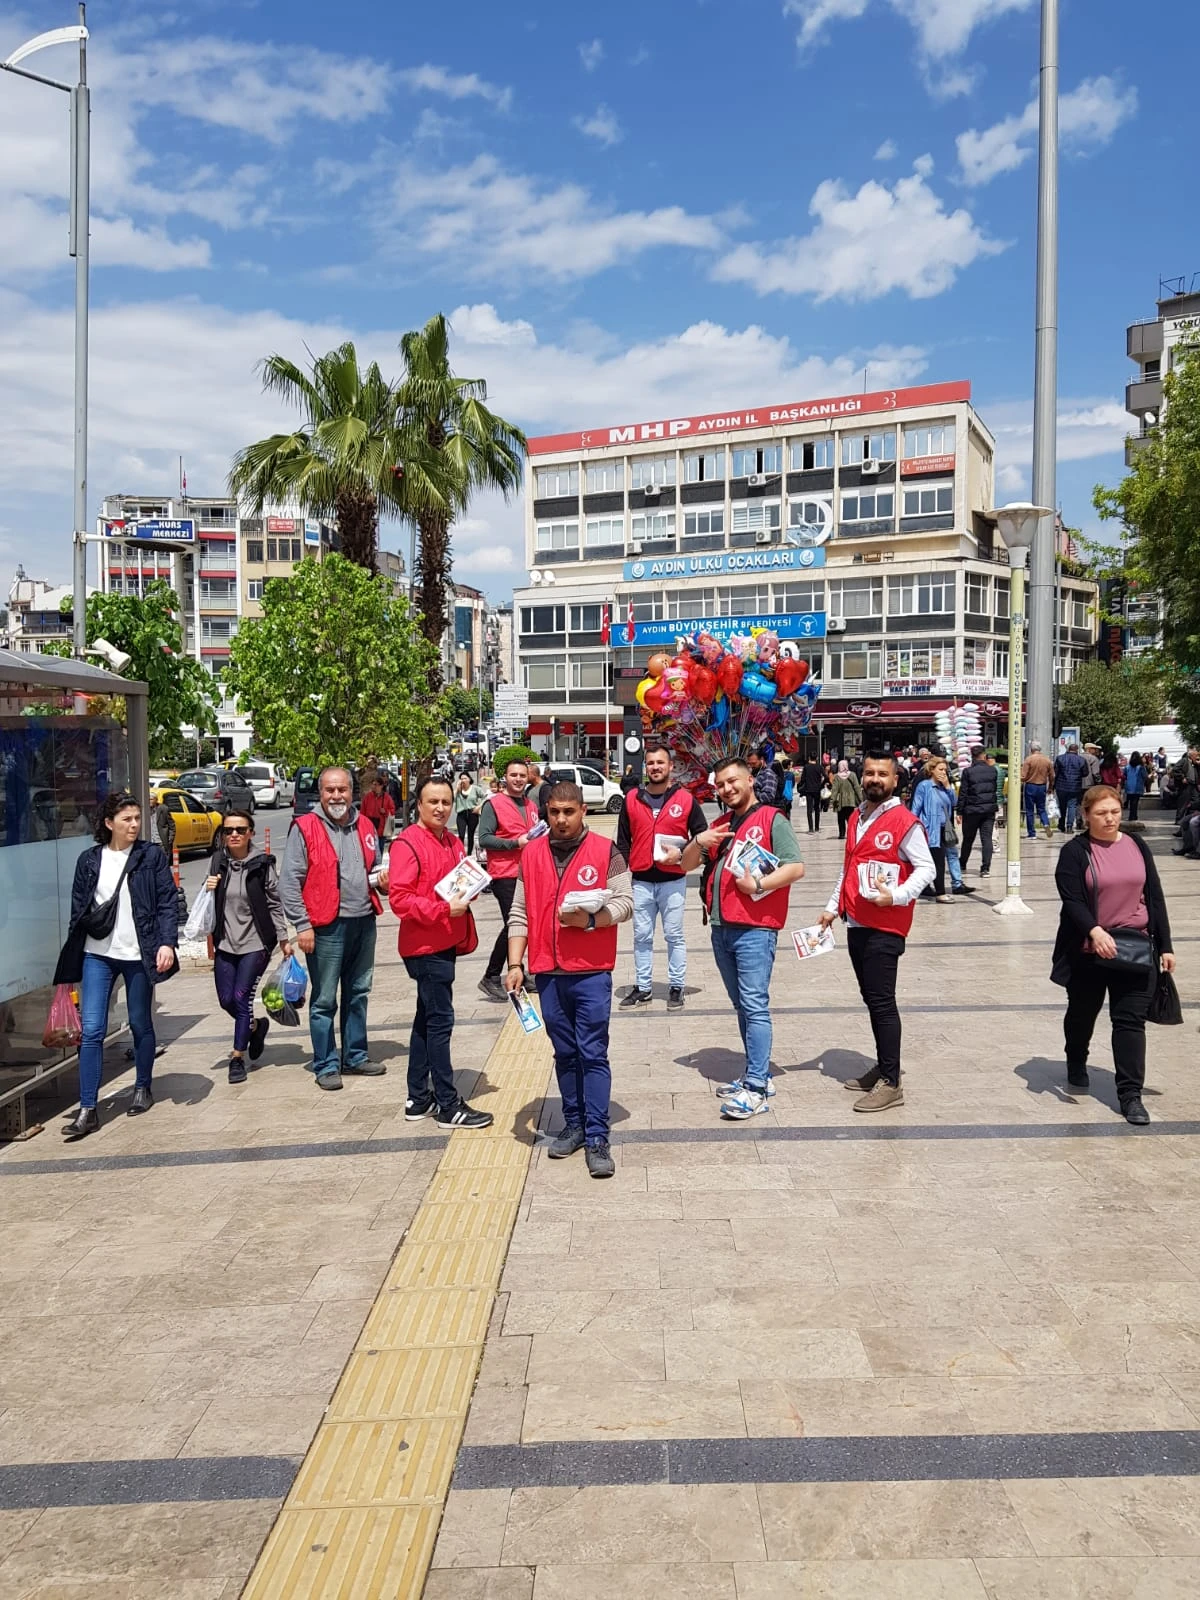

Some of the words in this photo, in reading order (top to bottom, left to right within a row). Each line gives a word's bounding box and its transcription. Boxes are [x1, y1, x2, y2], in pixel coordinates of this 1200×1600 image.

[609, 420, 691, 443] MHP
[698, 415, 741, 430] AYDIN
[745, 412, 758, 424] İL
[769, 399, 861, 421] BAŞKANLIĞI
[159, 521, 182, 529] KURS
[651, 559, 685, 575] AYDIN
[690, 555, 722, 571] ÜLKÜ
[728, 551, 794, 569] OCAKLARI
[642, 625, 667, 634] AYDIN
[668, 618, 739, 632] BÜYÜKŞEHİR
[741, 617, 791, 629] BELEDİYESİ
